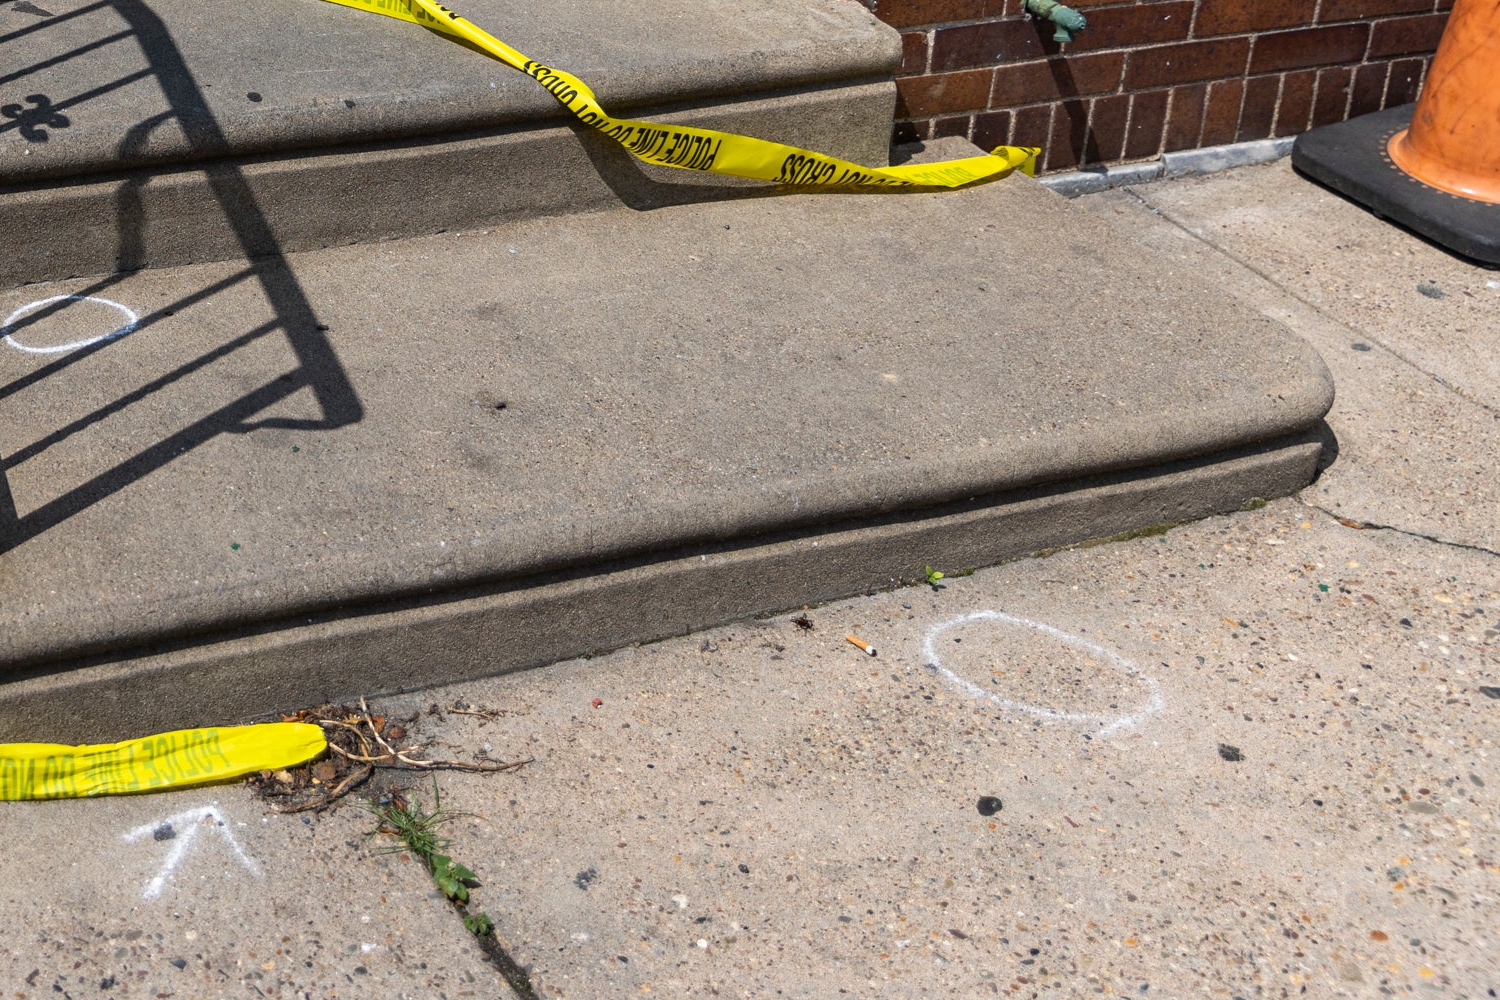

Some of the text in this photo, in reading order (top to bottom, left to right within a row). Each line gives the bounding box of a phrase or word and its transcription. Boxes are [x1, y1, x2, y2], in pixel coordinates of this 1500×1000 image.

[628, 127, 670, 162] LINE
[662, 132, 722, 171] POLICE
[773, 153, 838, 185] CROSS
